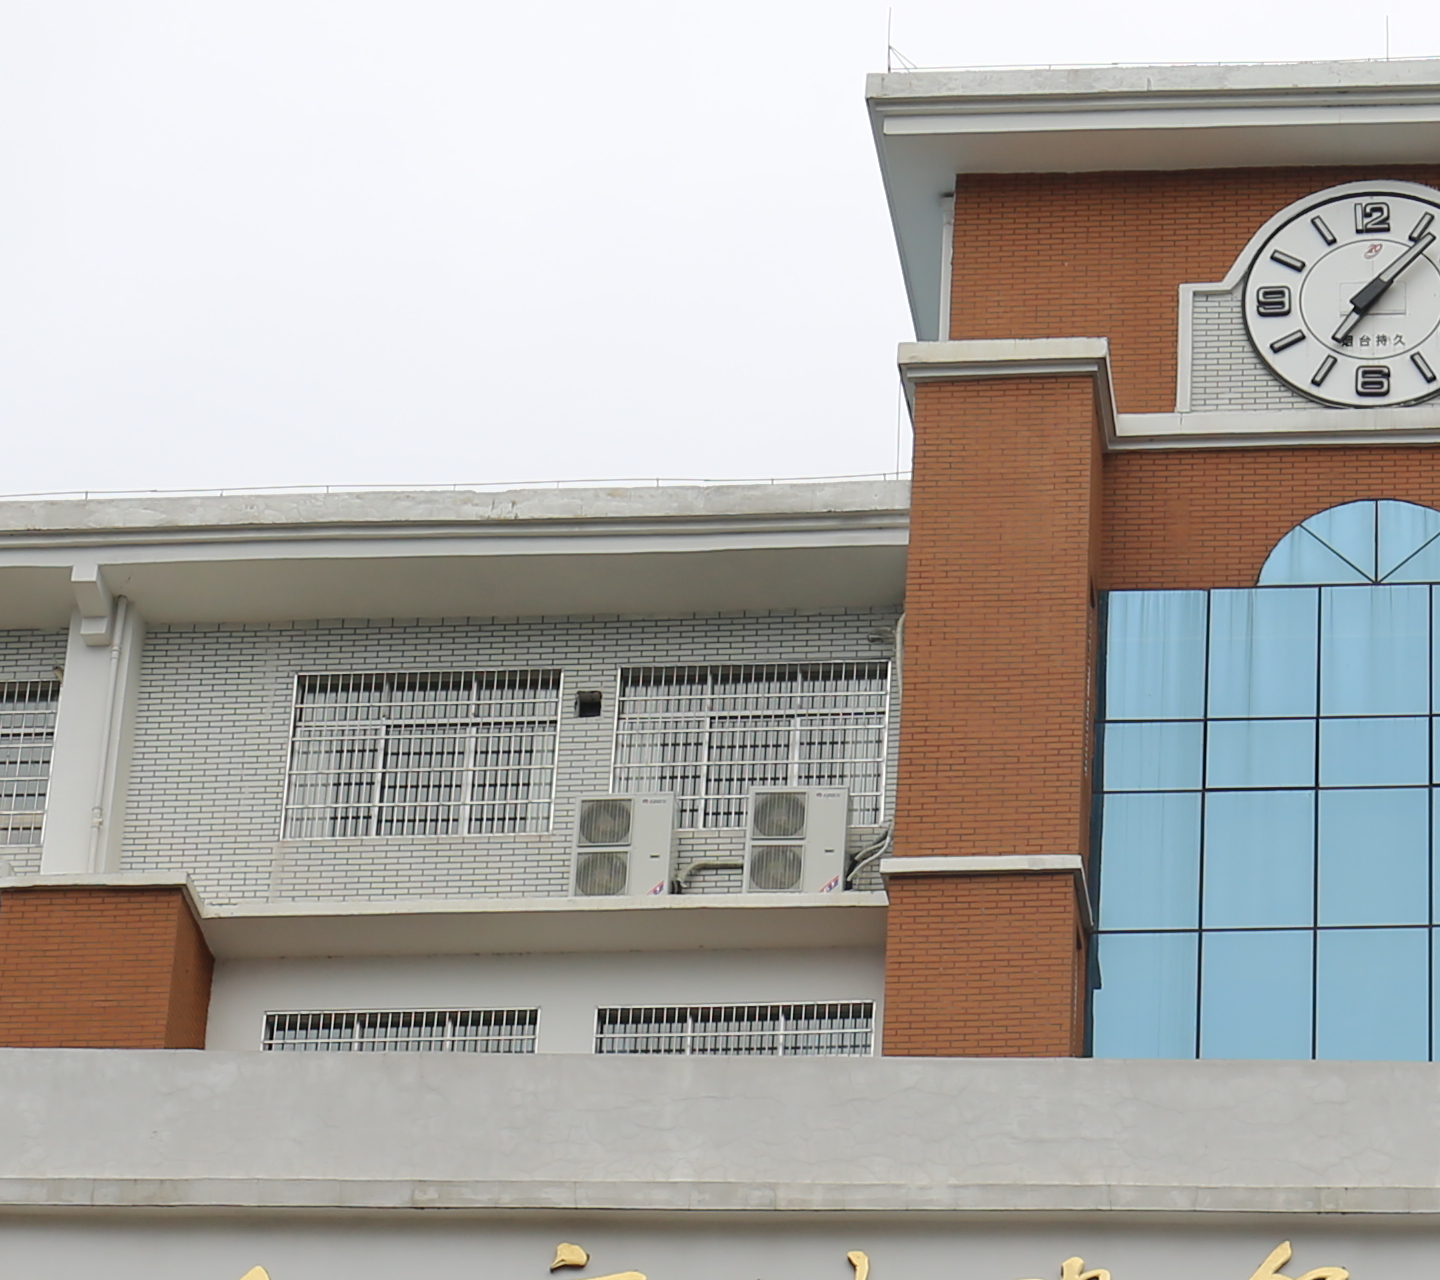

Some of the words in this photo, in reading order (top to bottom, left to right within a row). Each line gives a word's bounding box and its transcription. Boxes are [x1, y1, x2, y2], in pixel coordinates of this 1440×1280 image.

[1354, 202, 1390, 234] 12
[1256, 286, 1291, 316] 9
[1355, 365, 1390, 397] 6
